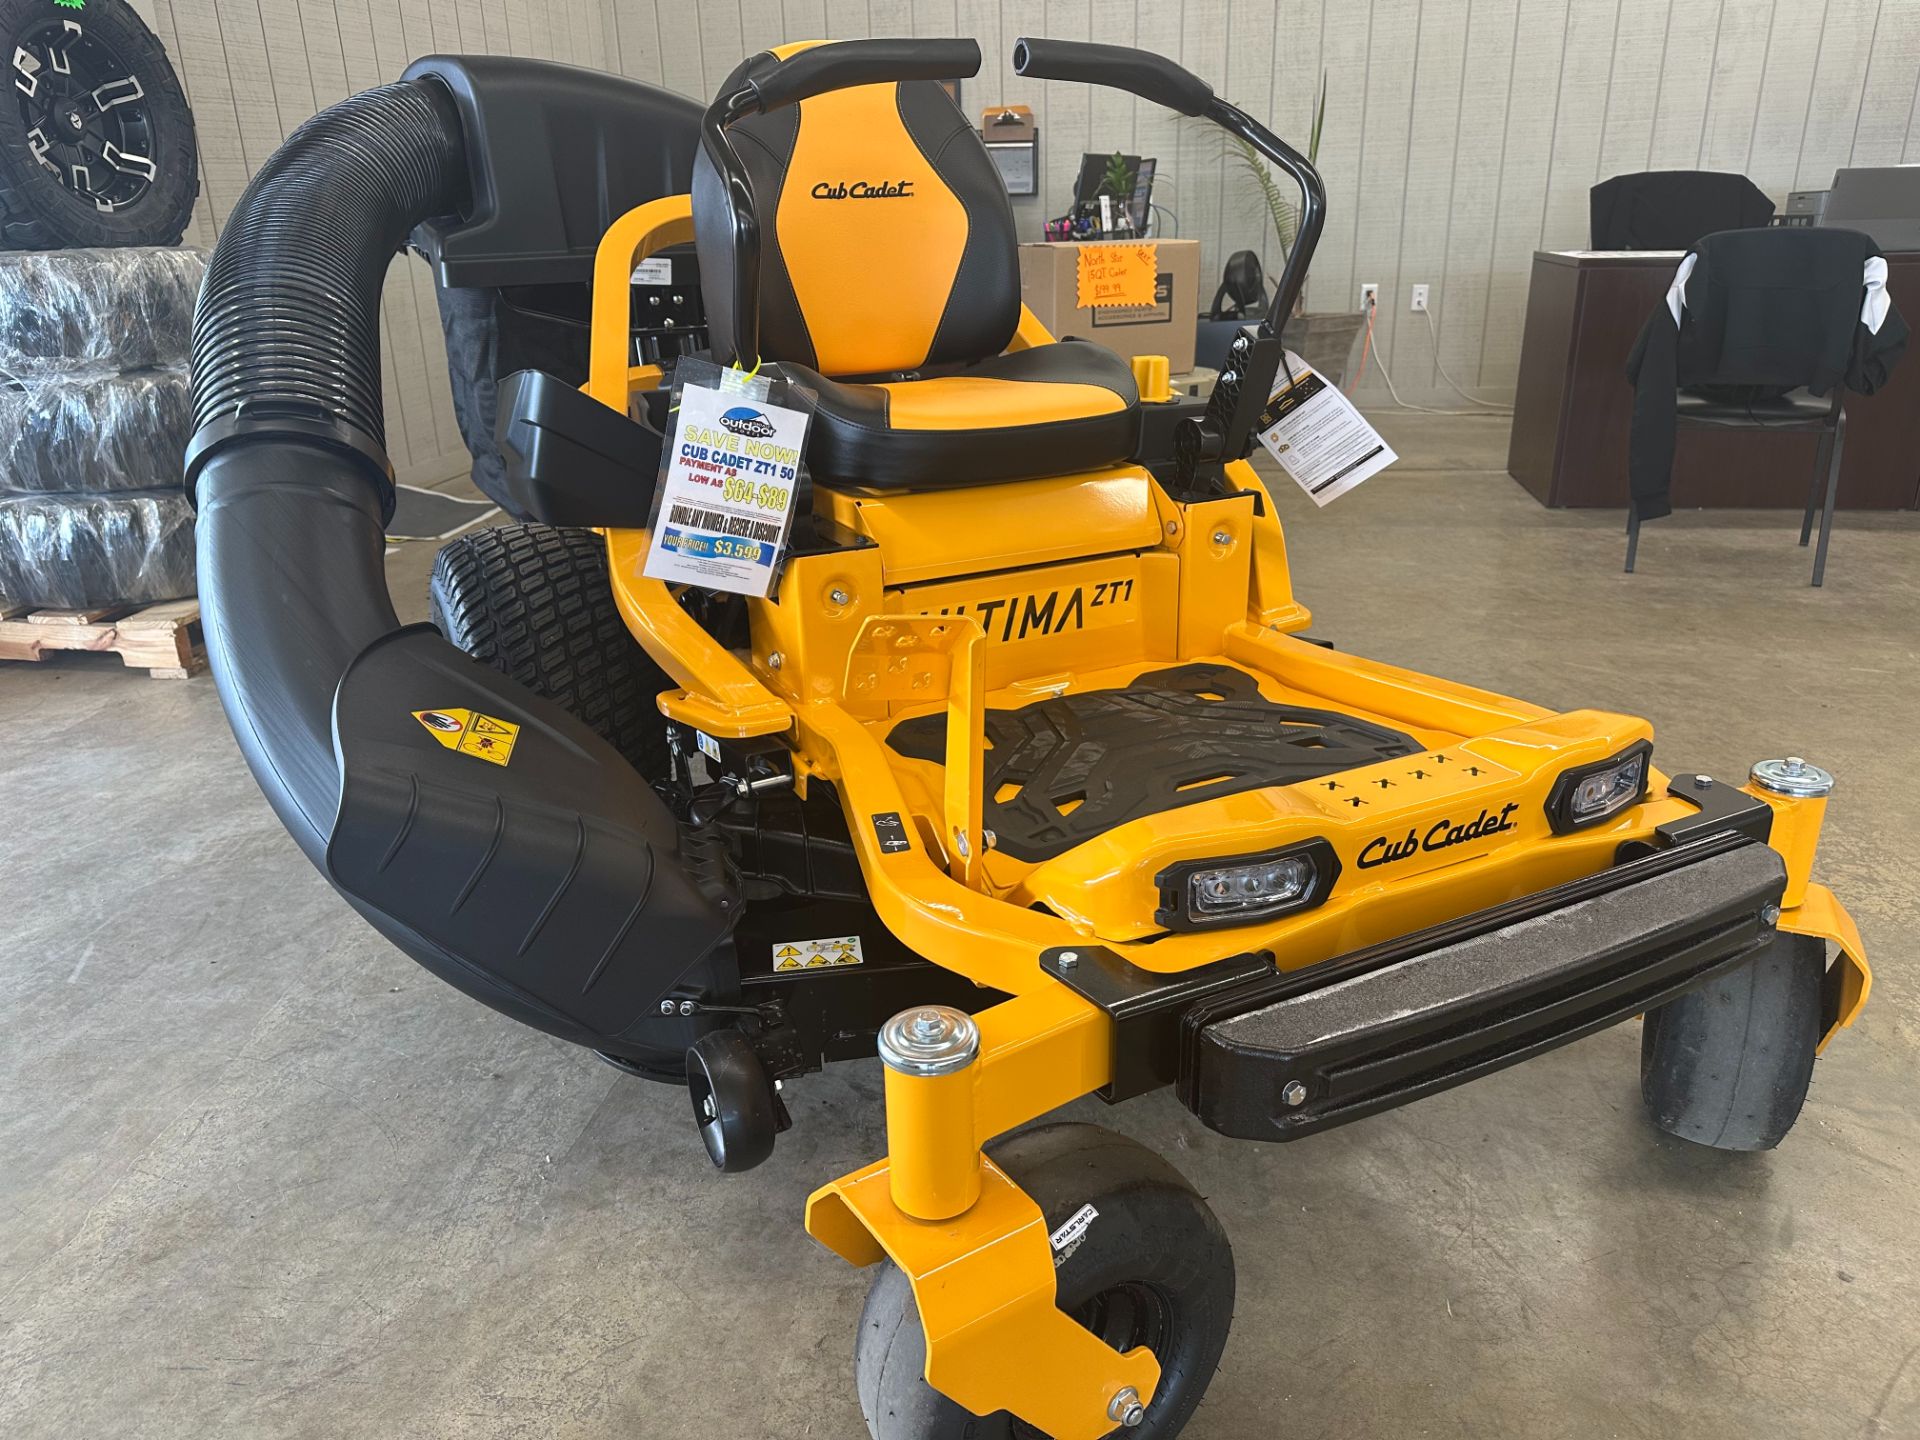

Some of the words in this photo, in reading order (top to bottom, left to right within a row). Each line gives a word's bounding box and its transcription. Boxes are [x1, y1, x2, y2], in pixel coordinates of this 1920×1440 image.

[811, 182, 848, 199] Cub
[849, 181, 914, 198] Cadet
[720, 417, 775, 436] outdoor
[681, 443, 708, 460] CUB
[711, 450, 753, 471] CADET
[754, 461, 777, 477] ZT1
[779, 467, 794, 480] 50
[684, 425, 738, 451] SAVE
[745, 439, 799, 466] NOW!
[679, 456, 723, 473] PAYMENT
[724, 467, 737, 477] AS
[688, 472, 710, 485] LOW
[710, 477, 724, 488] AS
[1090, 579, 1134, 608] ZT1
[920, 587, 1083, 642] TIMA
[1357, 828, 1419, 870] Cub
[1422, 802, 1520, 852] Cadet
[1055, 1208, 1094, 1244] CARLSTAR
